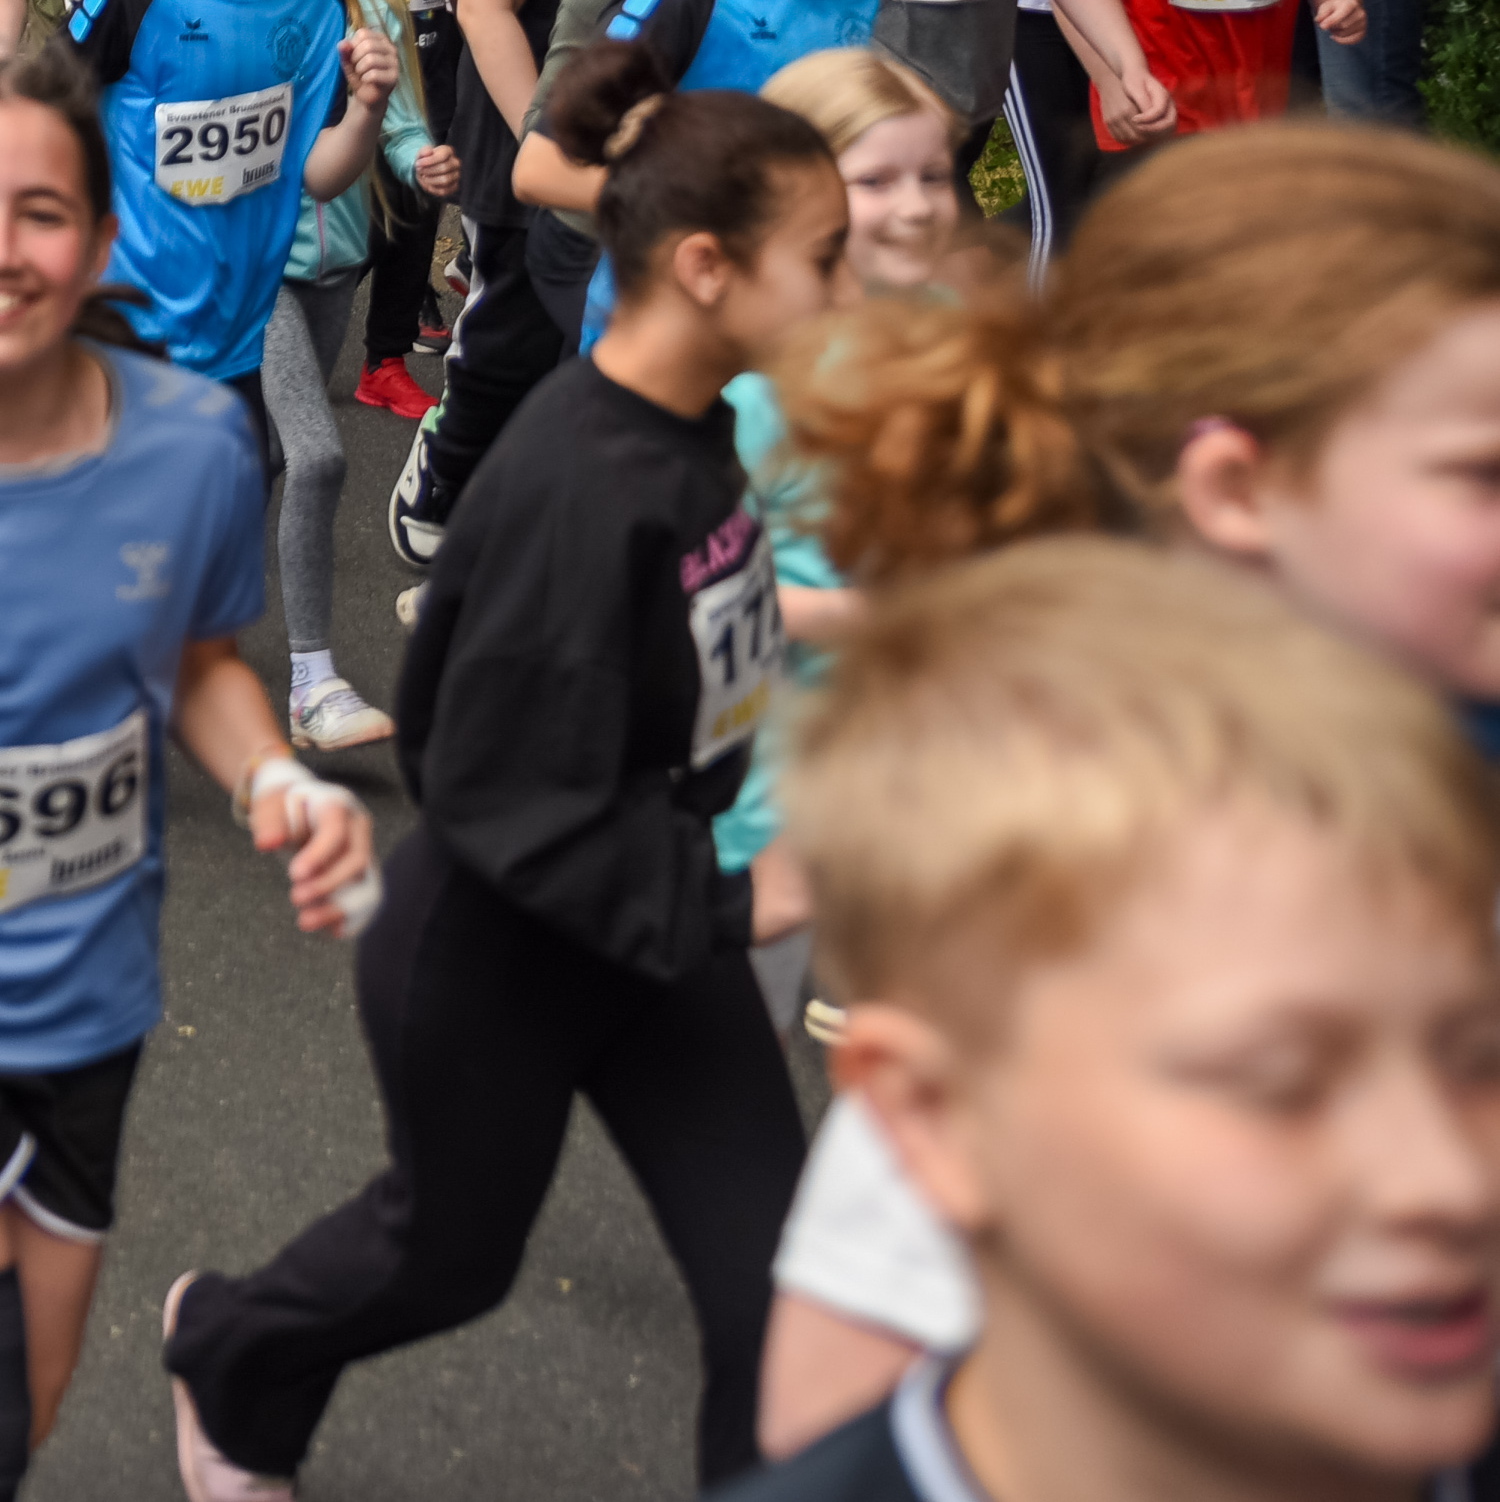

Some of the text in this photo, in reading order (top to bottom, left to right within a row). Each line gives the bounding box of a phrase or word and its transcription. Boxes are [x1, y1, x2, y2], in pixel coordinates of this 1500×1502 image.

[160, 106, 286, 165] 2950
[242, 159, 275, 185] bruns
[171, 175, 224, 197] EWE
